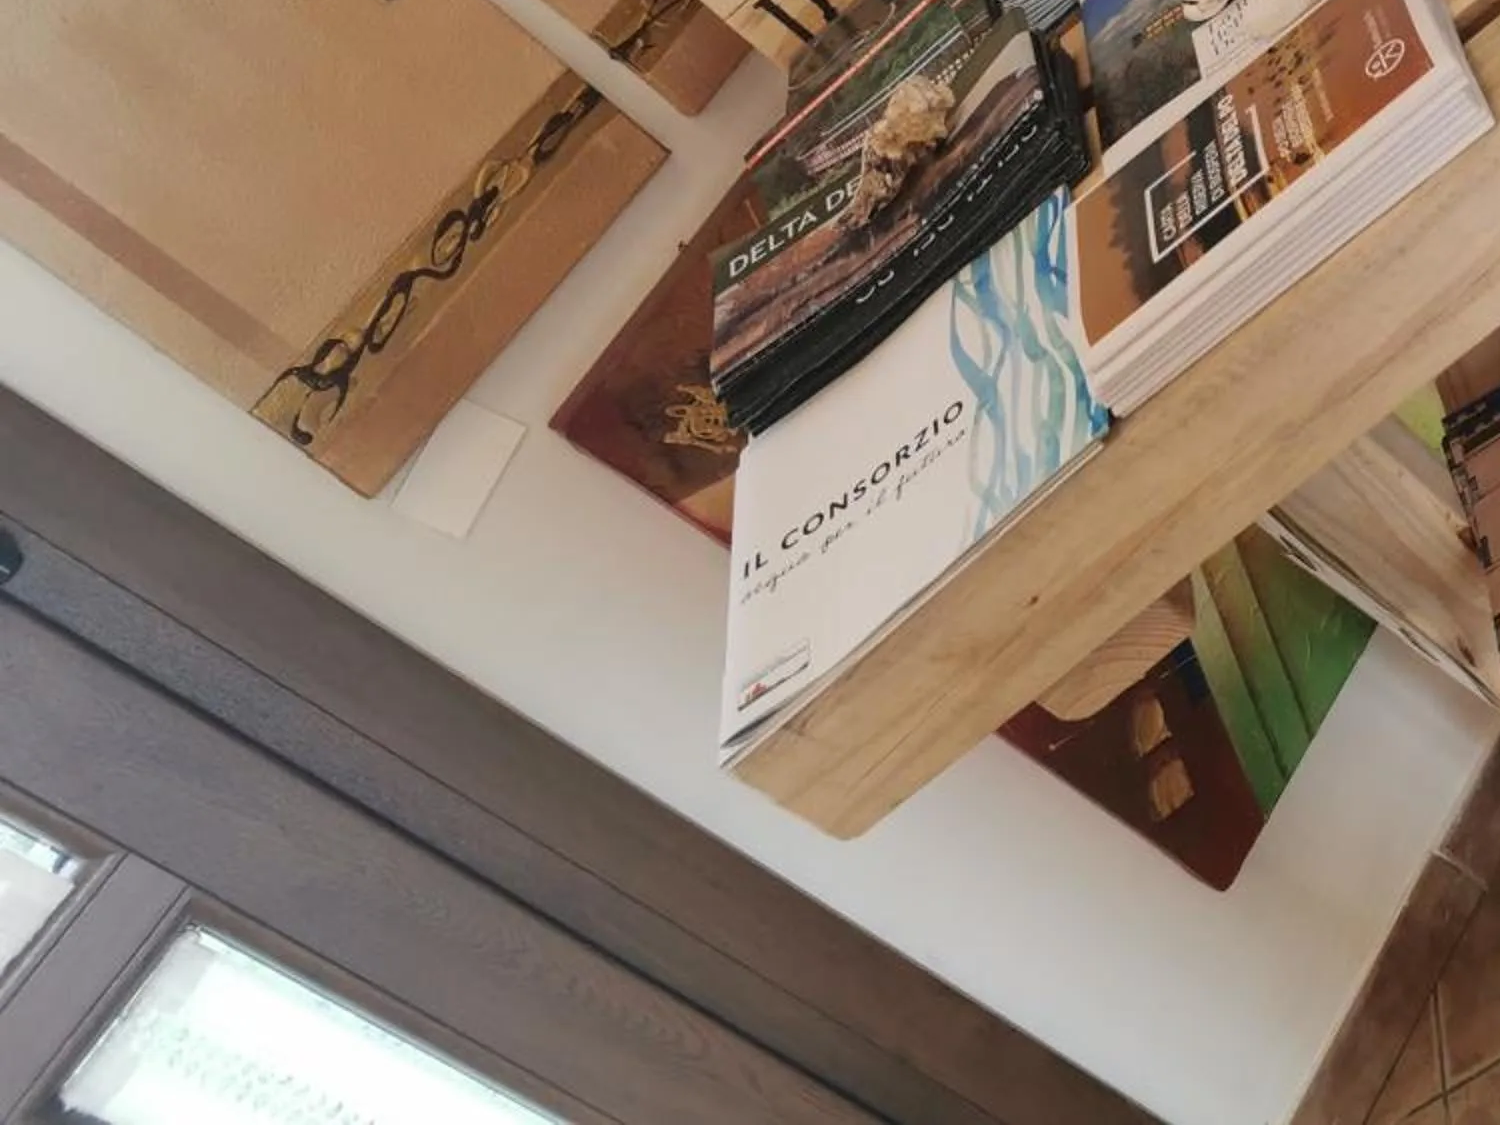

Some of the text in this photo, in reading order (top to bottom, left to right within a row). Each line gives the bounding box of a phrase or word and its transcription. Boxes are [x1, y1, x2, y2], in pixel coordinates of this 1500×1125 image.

[728, 208, 818, 278] DELTA
[741, 399, 965, 579] IL CONSORZIO
